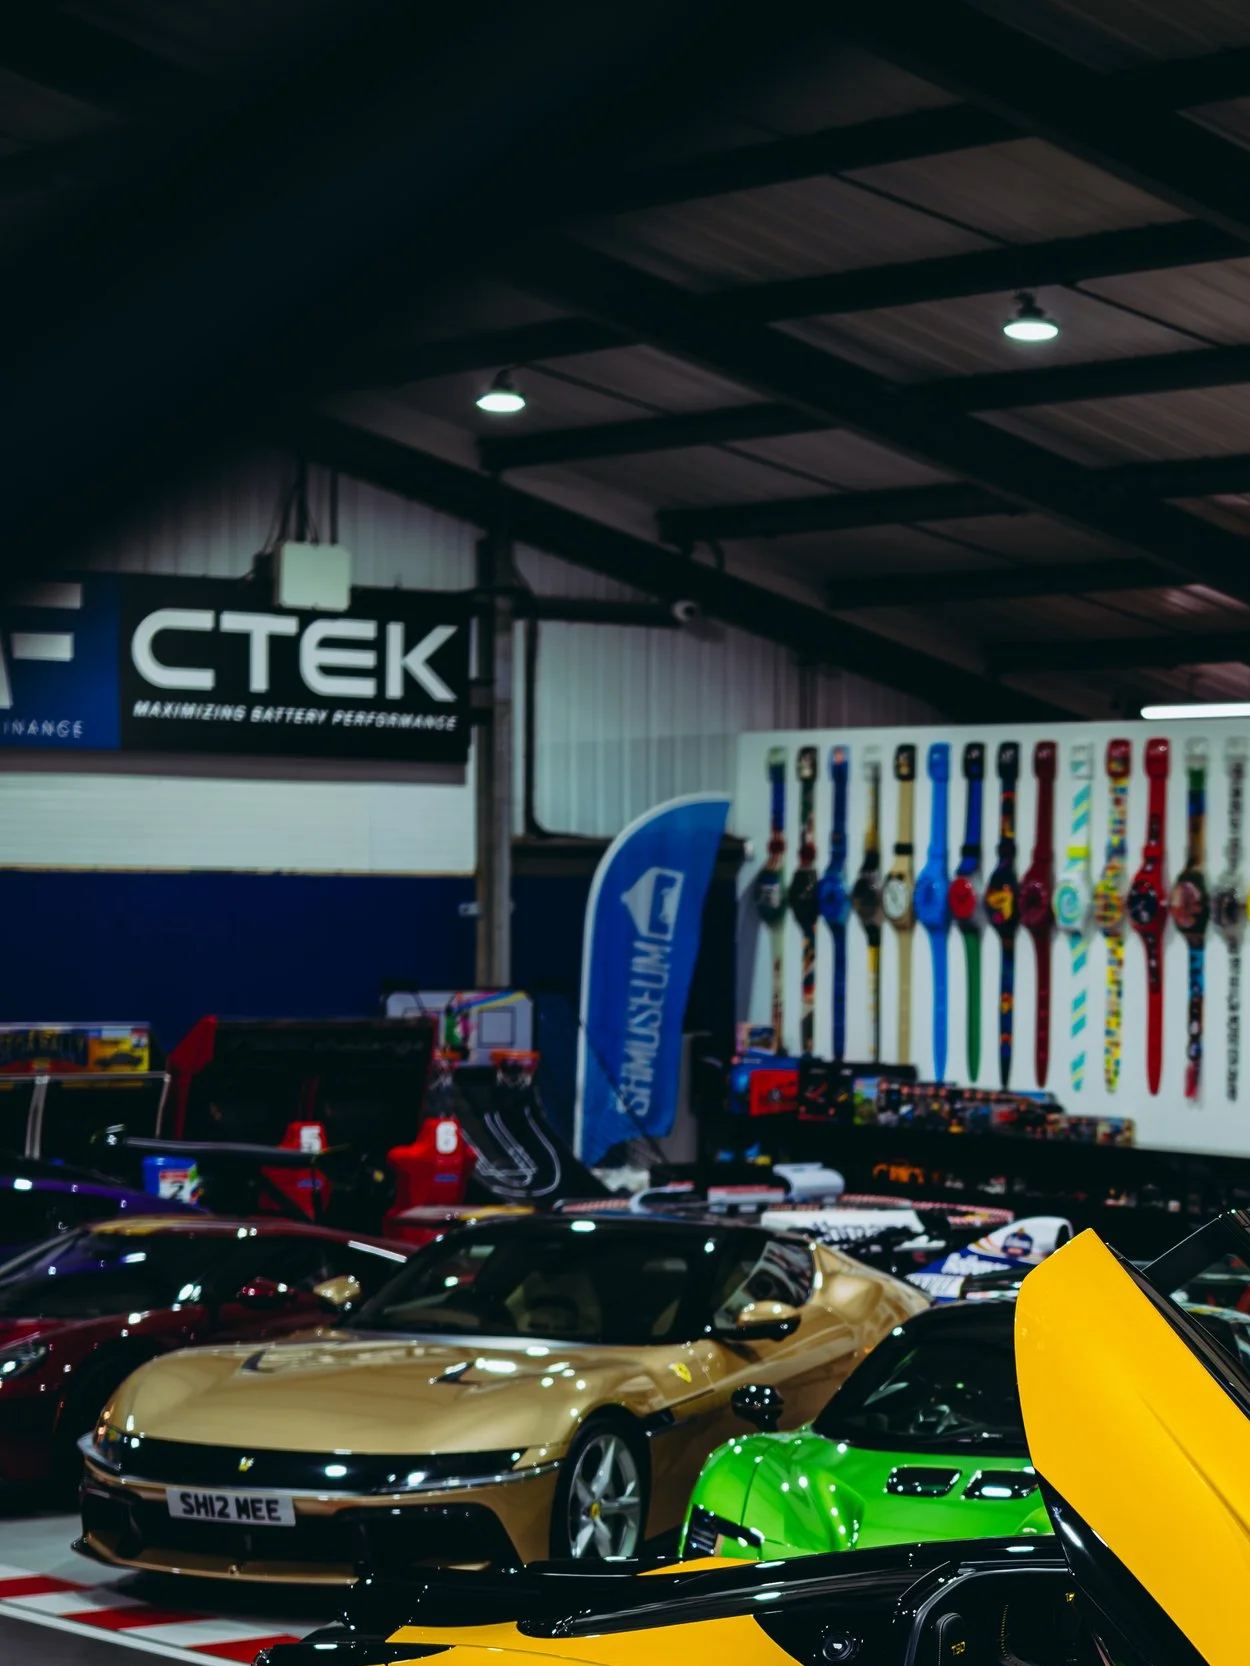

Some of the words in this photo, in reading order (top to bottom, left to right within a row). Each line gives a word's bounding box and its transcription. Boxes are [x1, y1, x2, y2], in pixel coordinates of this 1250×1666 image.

[131, 608, 458, 702] CTEK
[2, 718, 84, 738] INANCE
[133, 700, 247, 722] MAXIMIZING
[251, 705, 328, 725] BATTERY
[332, 709, 457, 731] PERFORMANCE
[300, 1125, 322, 1154] 5
[179, 1491, 231, 1519] SH12
[235, 1496, 281, 1521] MEE
